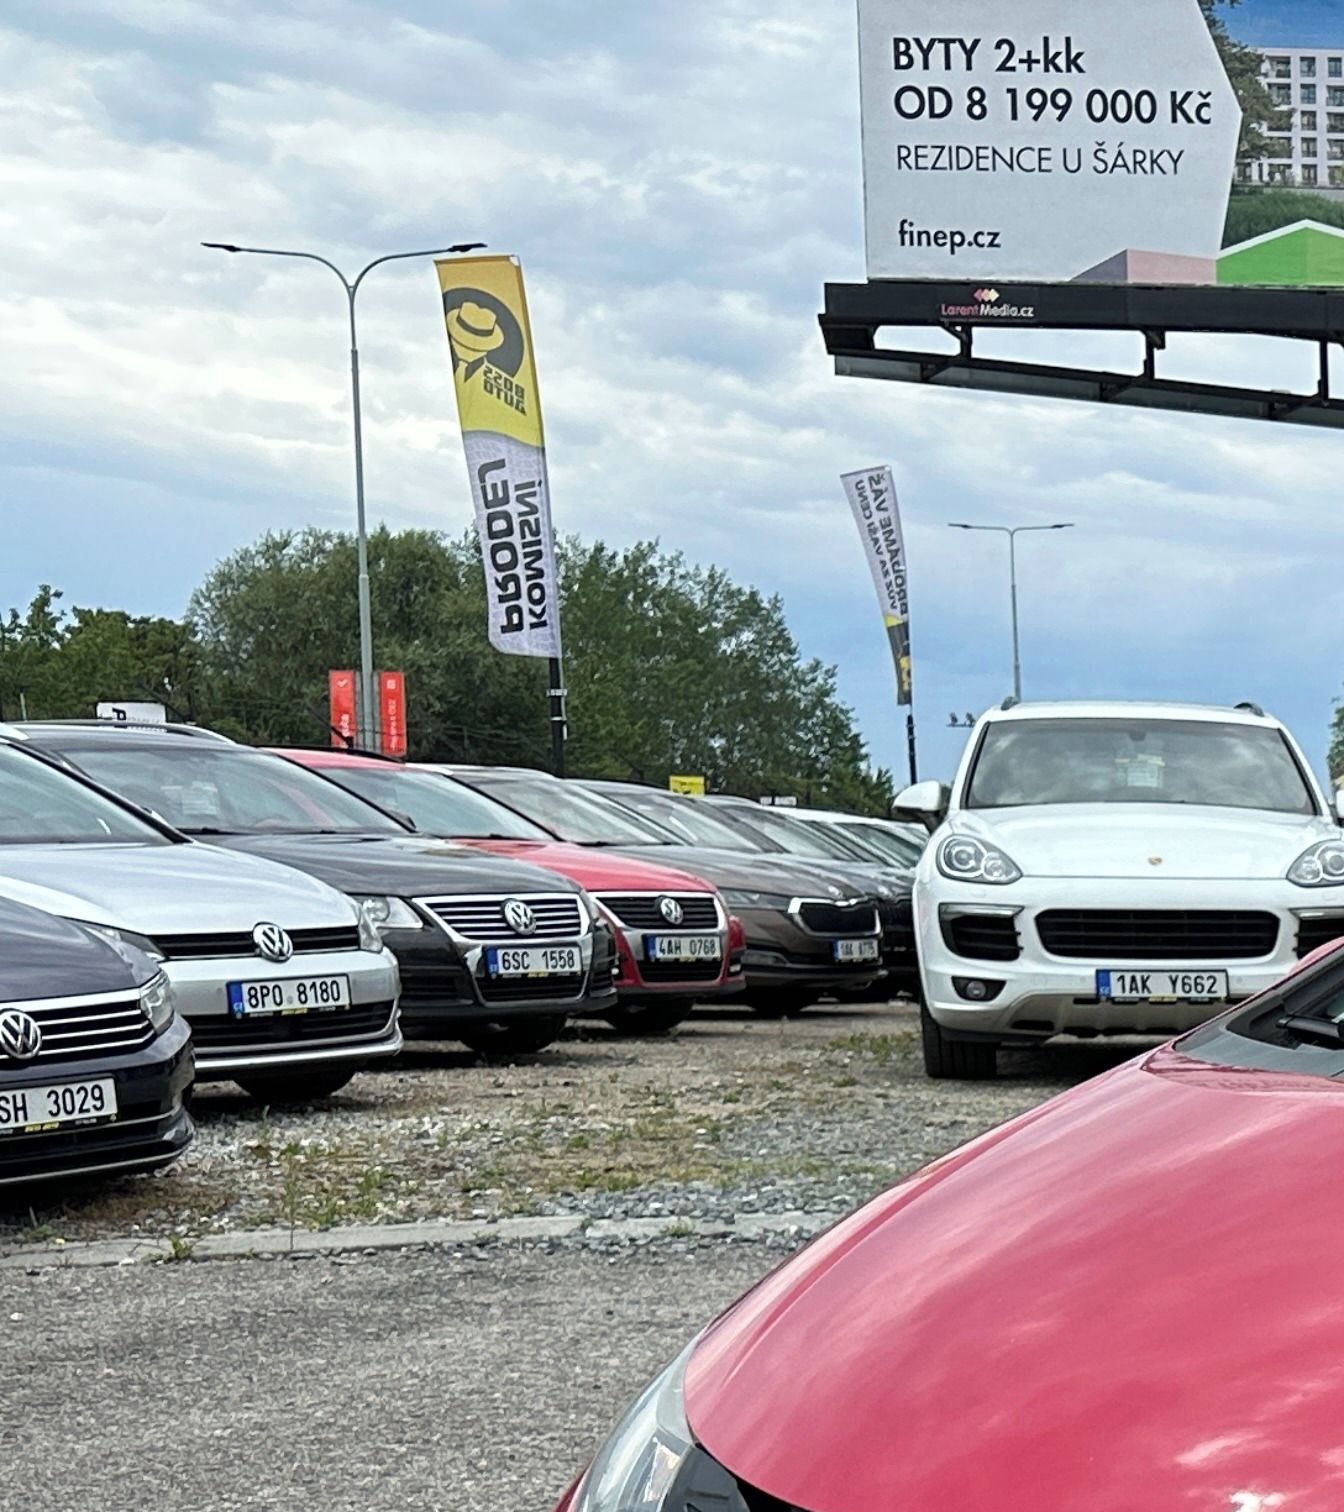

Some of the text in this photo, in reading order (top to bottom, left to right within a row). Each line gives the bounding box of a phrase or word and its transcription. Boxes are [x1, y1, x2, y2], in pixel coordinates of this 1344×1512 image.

[893, 36, 1086, 73] BYTY 2+kk
[894, 85, 1212, 125] OD 8 199 000 Kč
[897, 141, 1185, 175] REZIDENCE U ŠÁRKY
[899, 219, 1001, 255] finep.cz
[941, 304, 1034, 317] LarentMedia.cz
[502, 950, 575, 970] 6SC 1558
[297, 980, 340, 1004] 8180
[1117, 974, 1217, 994] 1AK Y662
[47, 1084, 105, 1117] 3029
